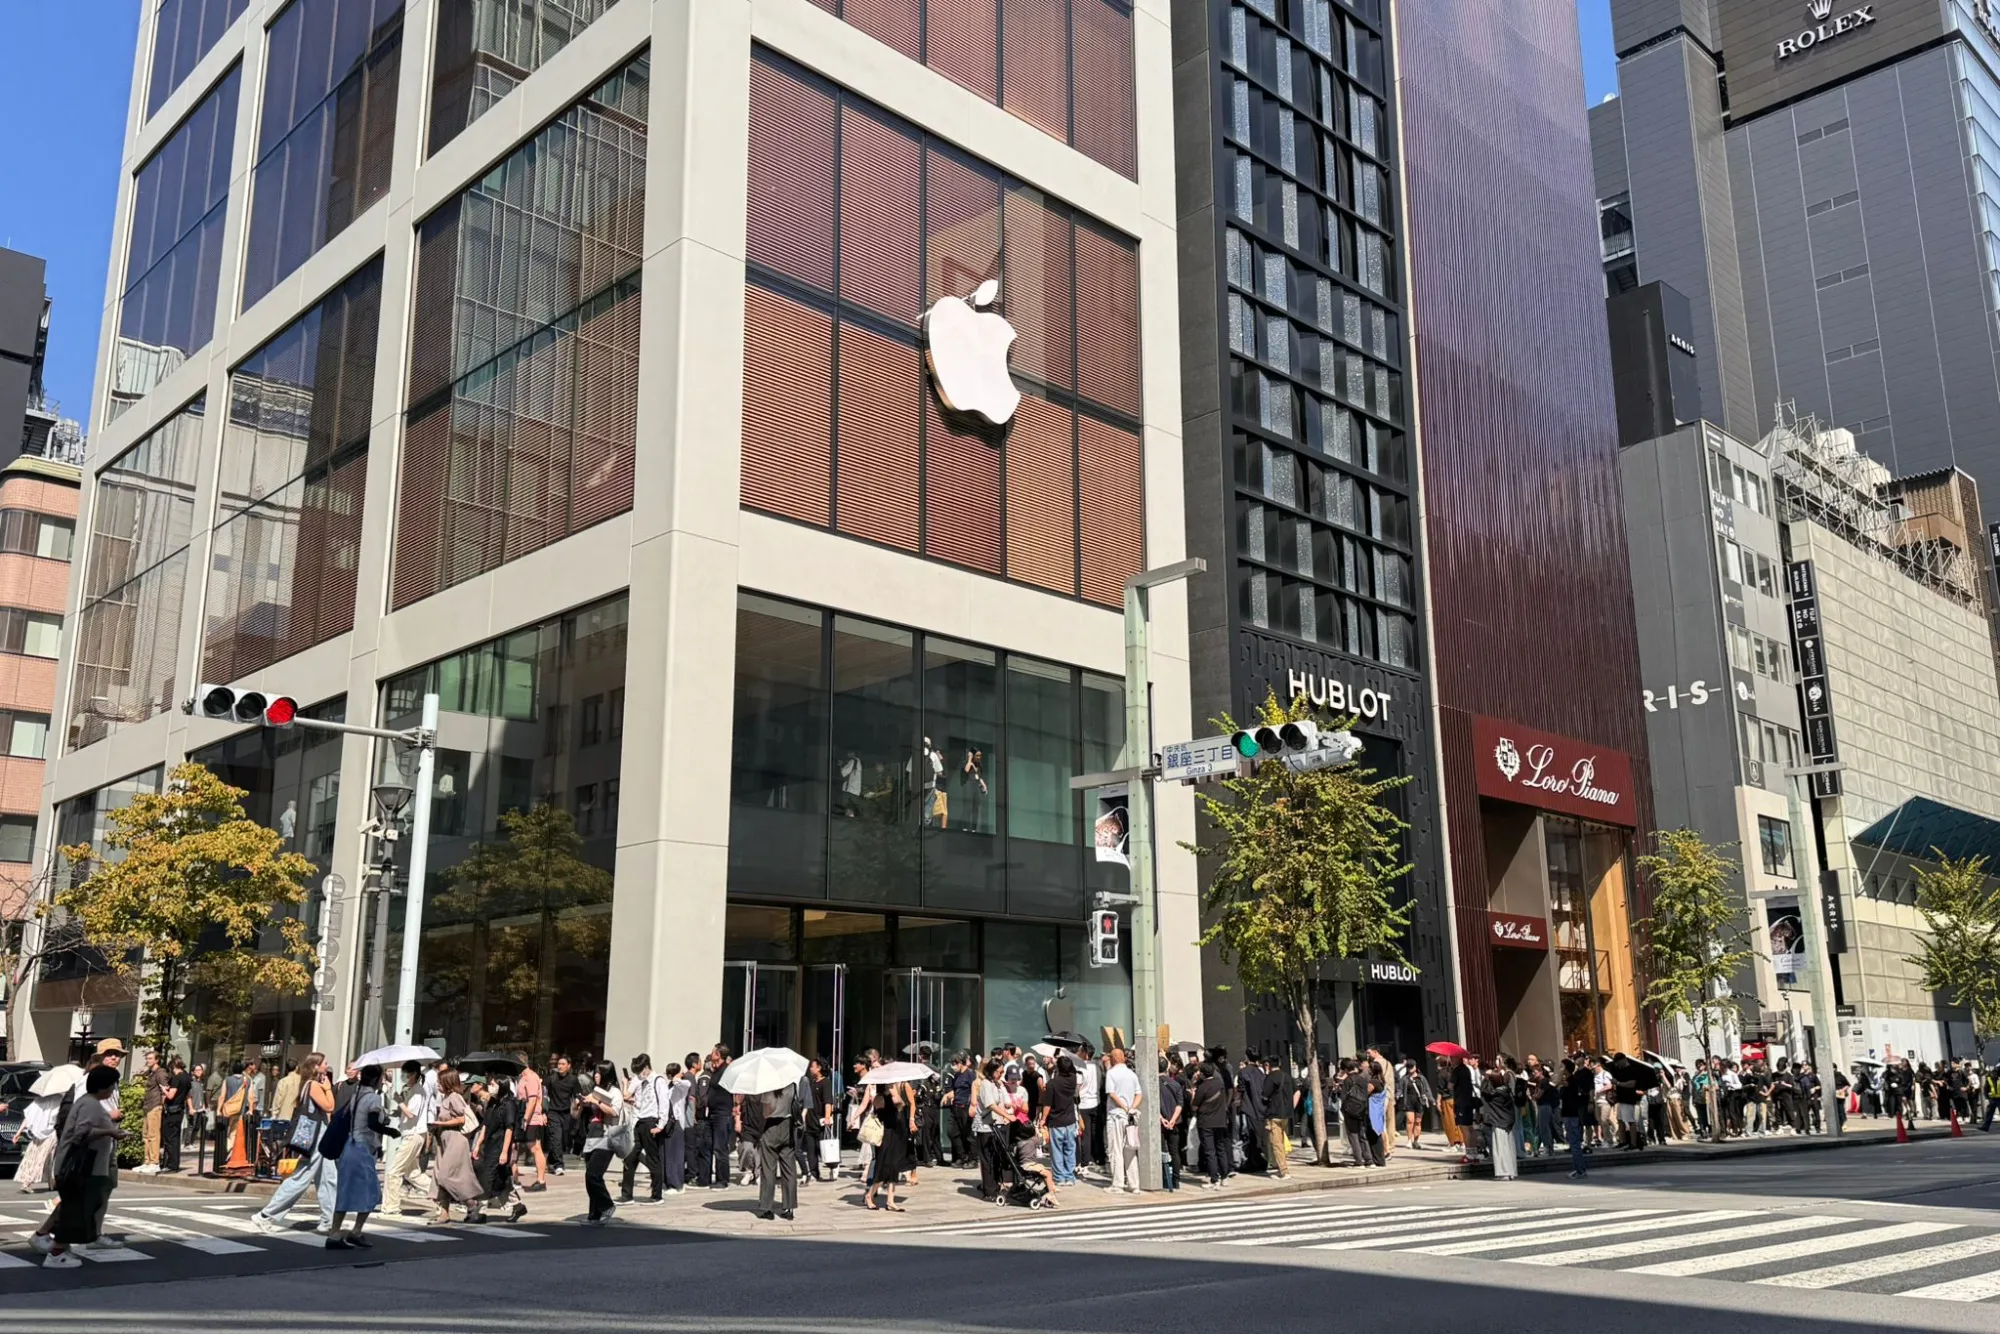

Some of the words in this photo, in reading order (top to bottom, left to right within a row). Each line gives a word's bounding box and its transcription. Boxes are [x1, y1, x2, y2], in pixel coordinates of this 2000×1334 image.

[1777, 4, 1875, 59] ROLEX
[1288, 667, 1391, 721] HUBLOT
[1166, 744, 1188, 753] 中央区
[1167, 745, 1233, 769] 銀座三丁目
[1186, 766, 1206, 775] Ginza
[1207, 763, 1213, 772] 3
[1521, 744, 1569, 793] Loro
[1569, 755, 1619, 805] Piana
